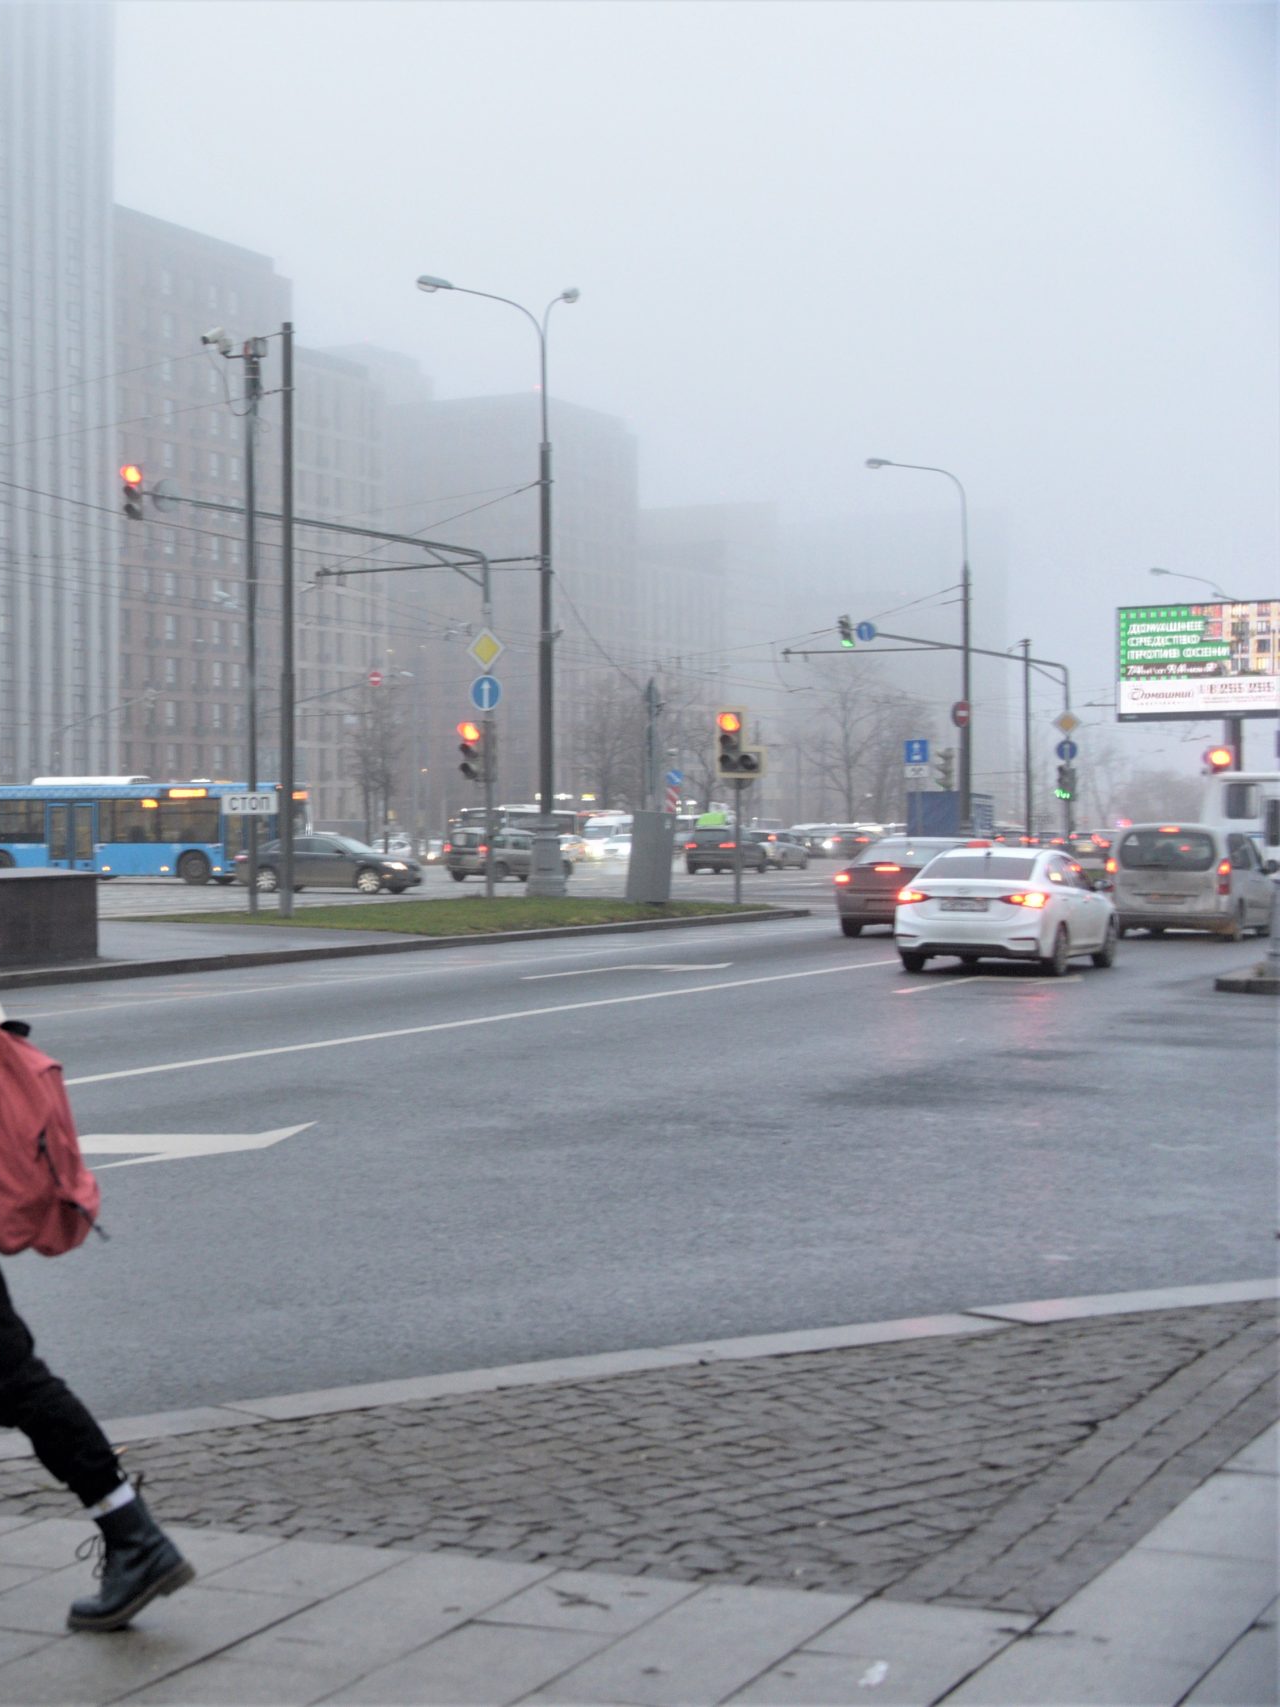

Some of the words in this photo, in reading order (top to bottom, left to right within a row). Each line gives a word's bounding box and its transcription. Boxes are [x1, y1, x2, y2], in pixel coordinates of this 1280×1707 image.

[1127, 621, 1205, 635] ДОМАШНЕЕ
[1127, 634, 1200, 647] СРЕДСТВО
[1127, 648, 1180, 661] ПРОТИВ
[1182, 646, 1231, 658] ОСЕНИ
[228, 796, 271, 811] СТОП
